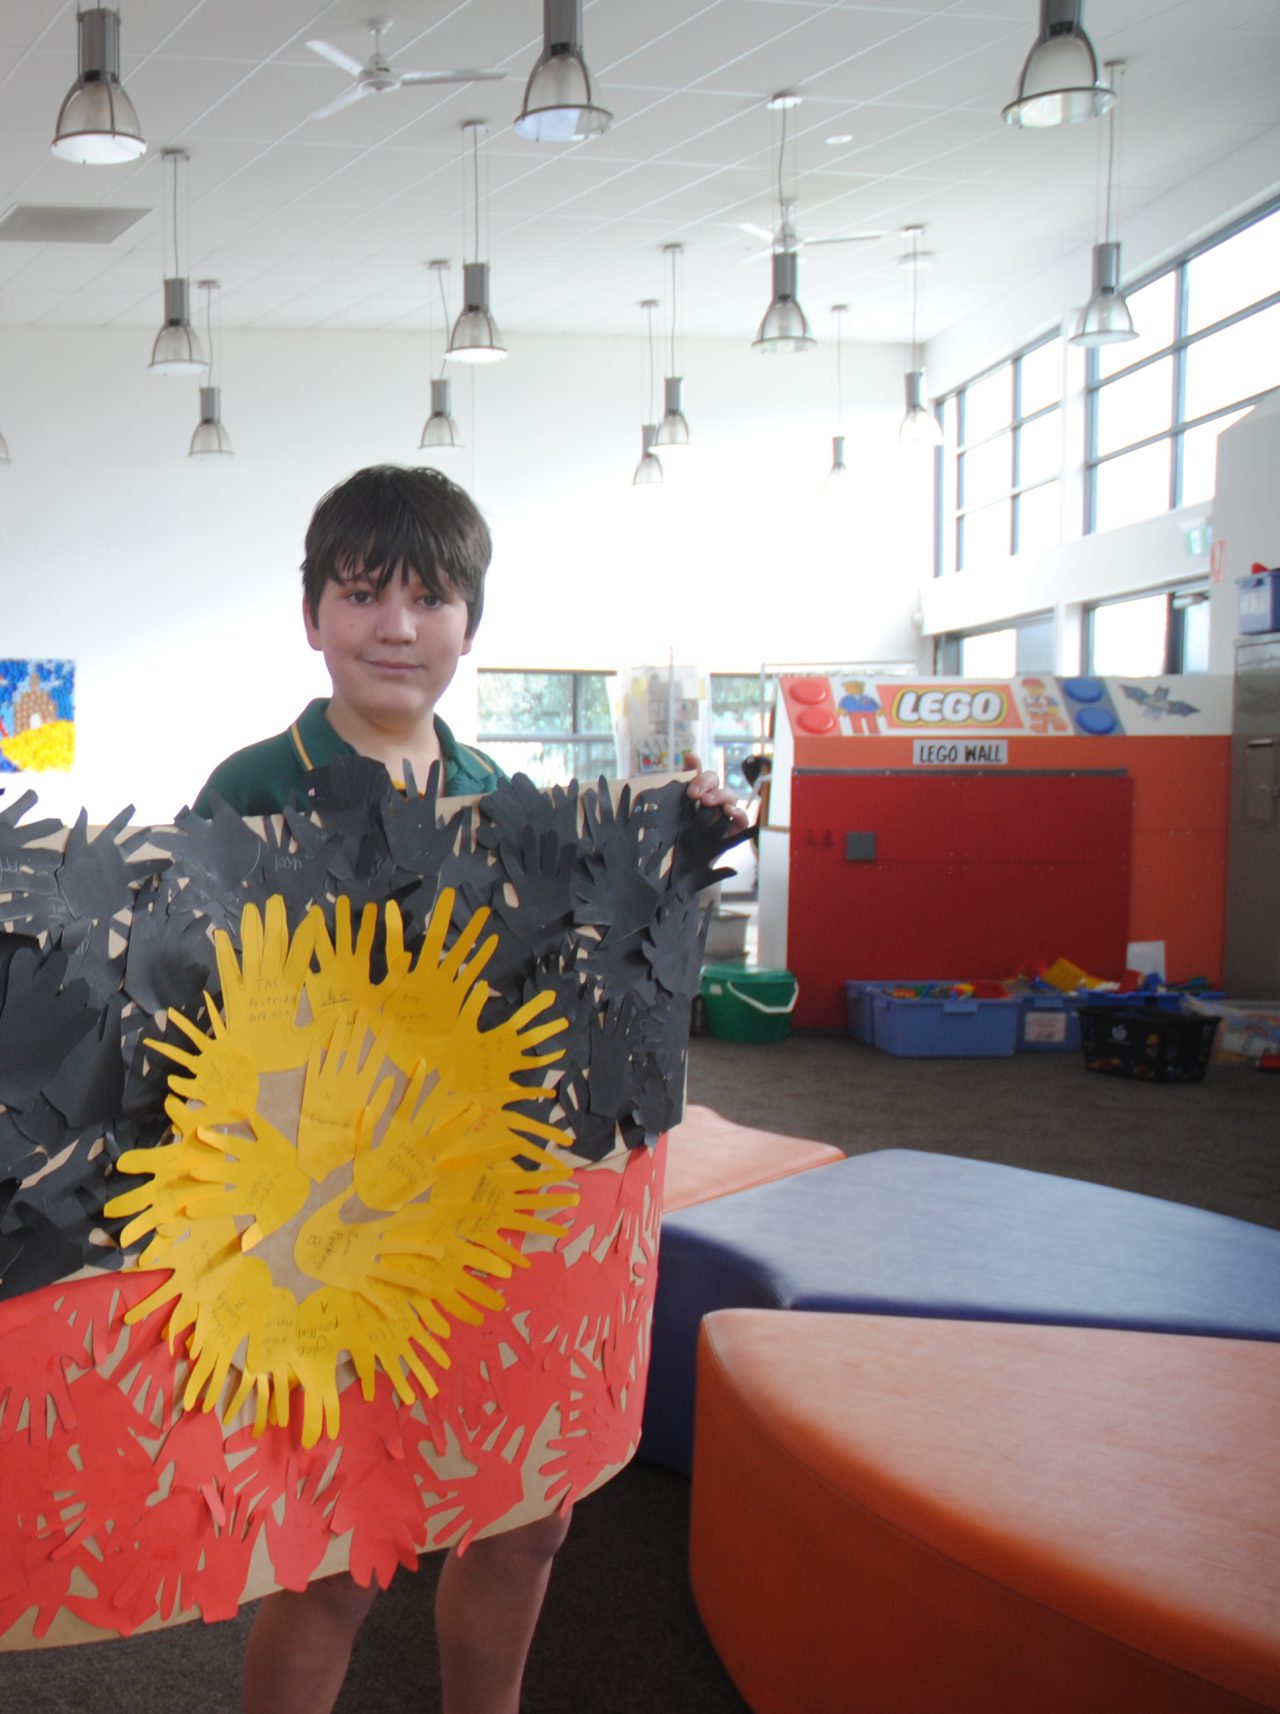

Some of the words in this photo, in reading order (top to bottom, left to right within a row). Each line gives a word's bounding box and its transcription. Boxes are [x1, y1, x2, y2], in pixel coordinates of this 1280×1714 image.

[898, 690, 1002, 722] LEGO
[920, 744, 959, 763] LEGO
[964, 744, 1004, 763] WALL
